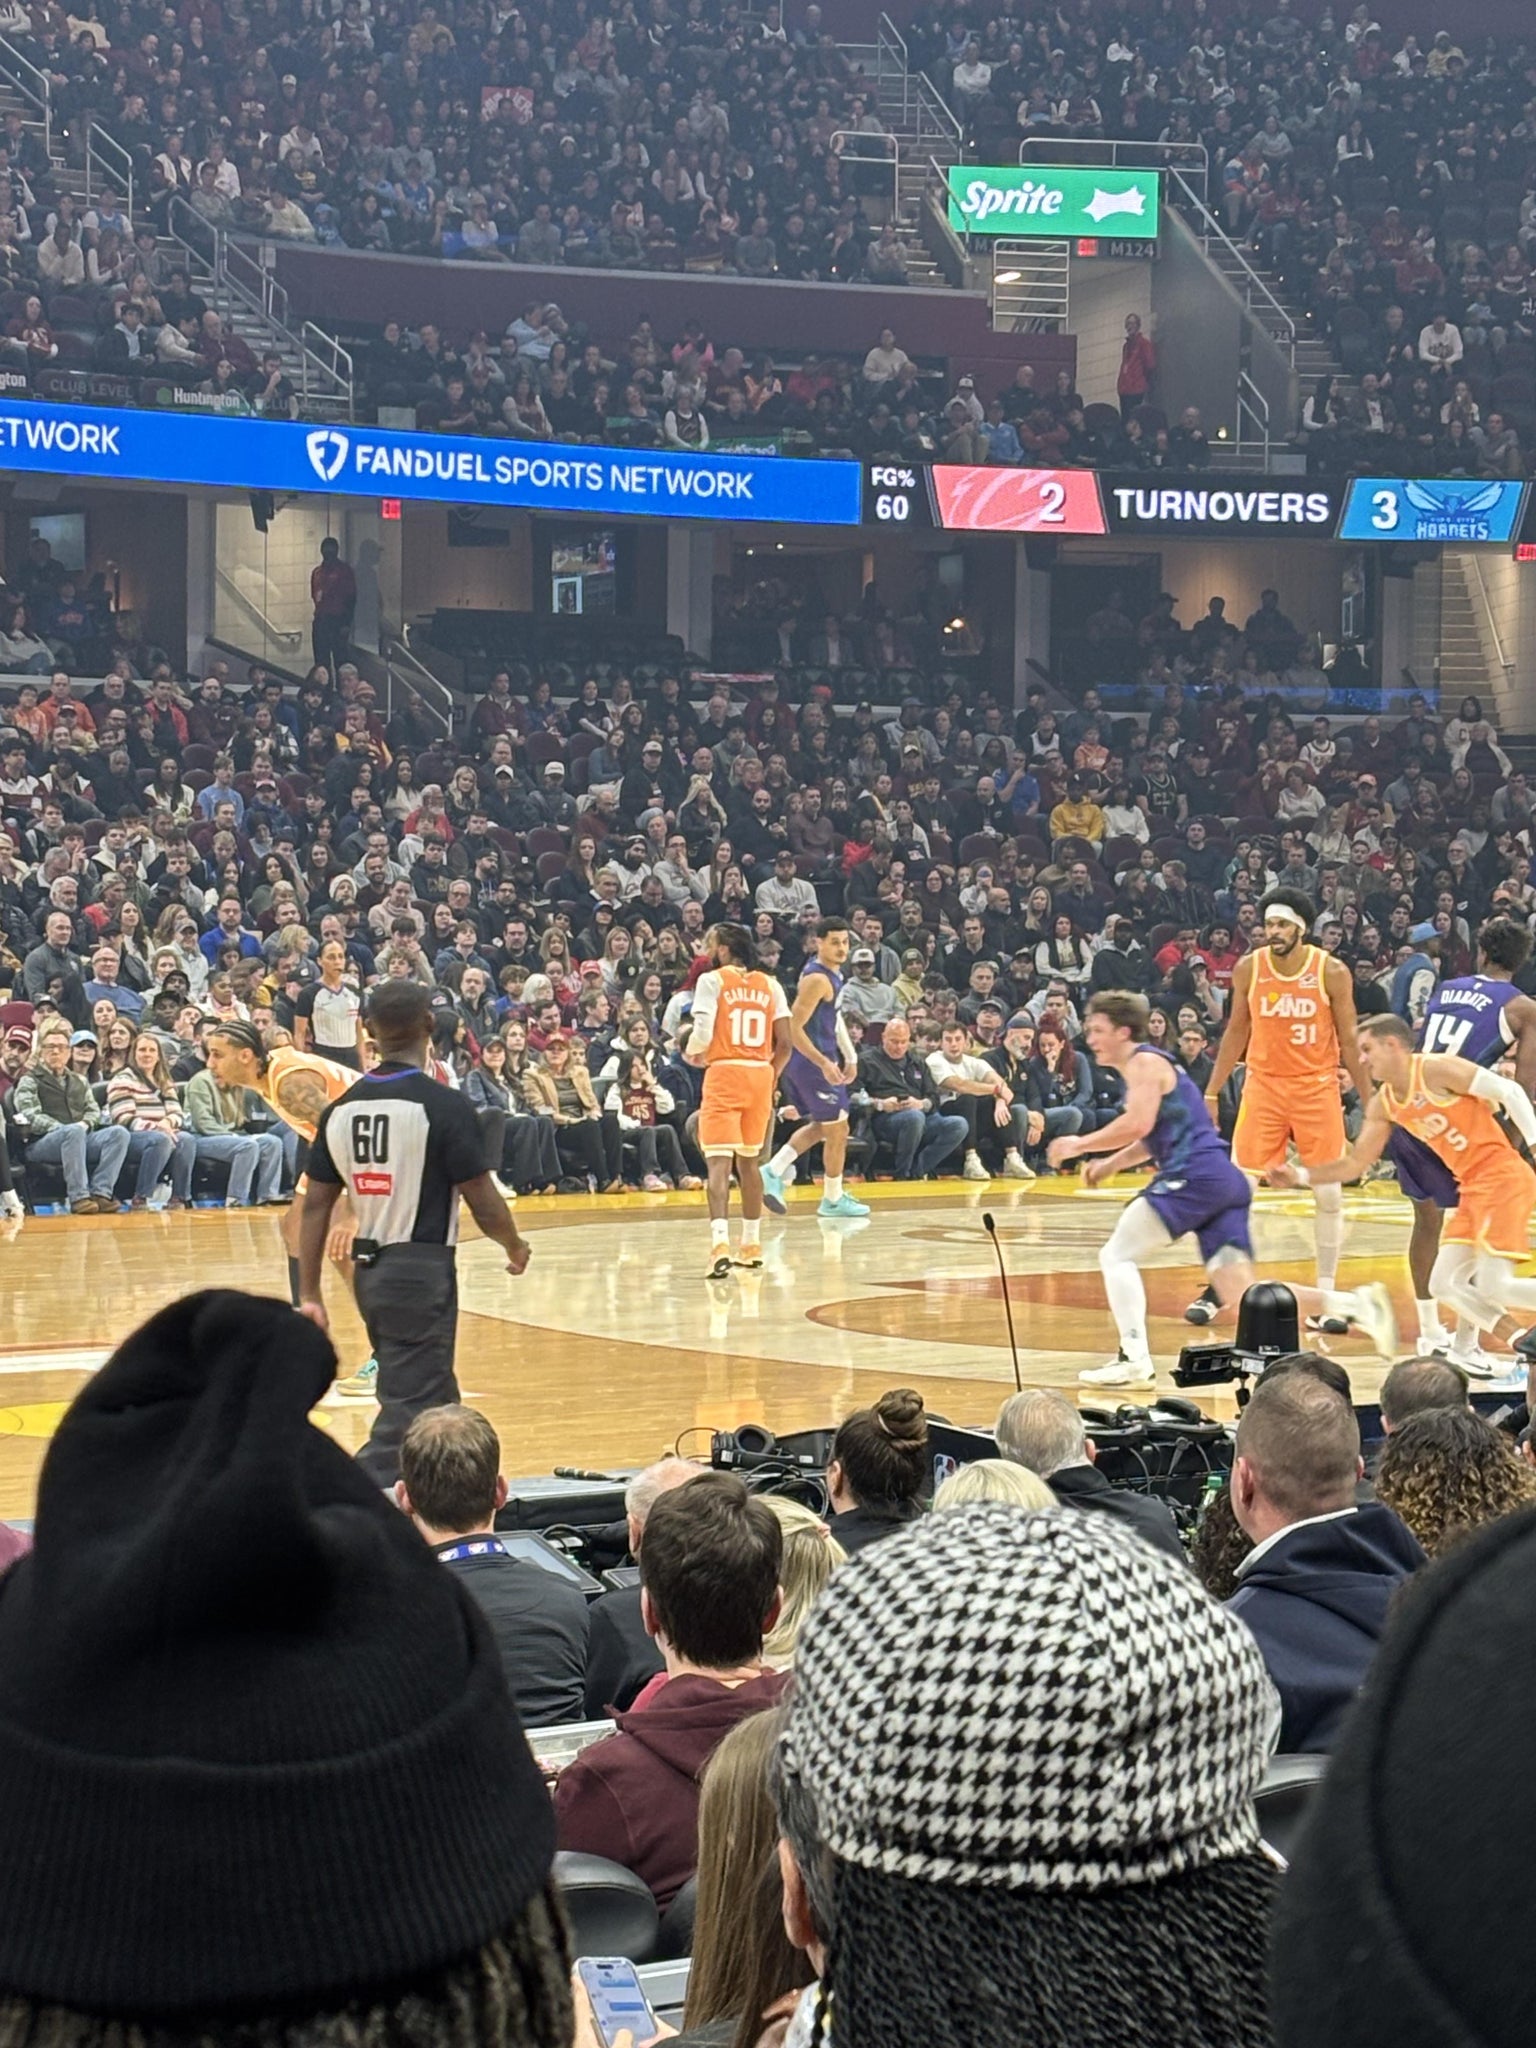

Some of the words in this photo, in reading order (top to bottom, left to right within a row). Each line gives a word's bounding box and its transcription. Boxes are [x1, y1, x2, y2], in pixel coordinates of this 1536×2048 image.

[960, 180, 1064, 220] Sprite
[1110, 241, 1154, 257] M124
[49, 378, 87, 394] CLUB
[91, 383, 134, 399] LEVEL
[173, 387, 241, 410] Huntington
[356, 445, 490, 482] FANDUEL
[494, 455, 603, 491] SPORTS
[610, 464, 754, 499] NETWORK
[871, 467, 916, 488] FG%
[876, 495, 909, 521] 60
[1038, 482, 1066, 523] 2
[1113, 488, 1330, 523] TURNOVERS
[1371, 490, 1399, 530] 3
[1416, 521, 1489, 540] HORNETS
[1260, 995, 1317, 1018] LAND
[1440, 989, 1494, 1012] DIABATE
[728, 1007, 767, 1048] 10
[1289, 1022, 1317, 1046] 31
[1421, 1012, 1475, 1055] 14
[352, 1113, 390, 1165] 60
